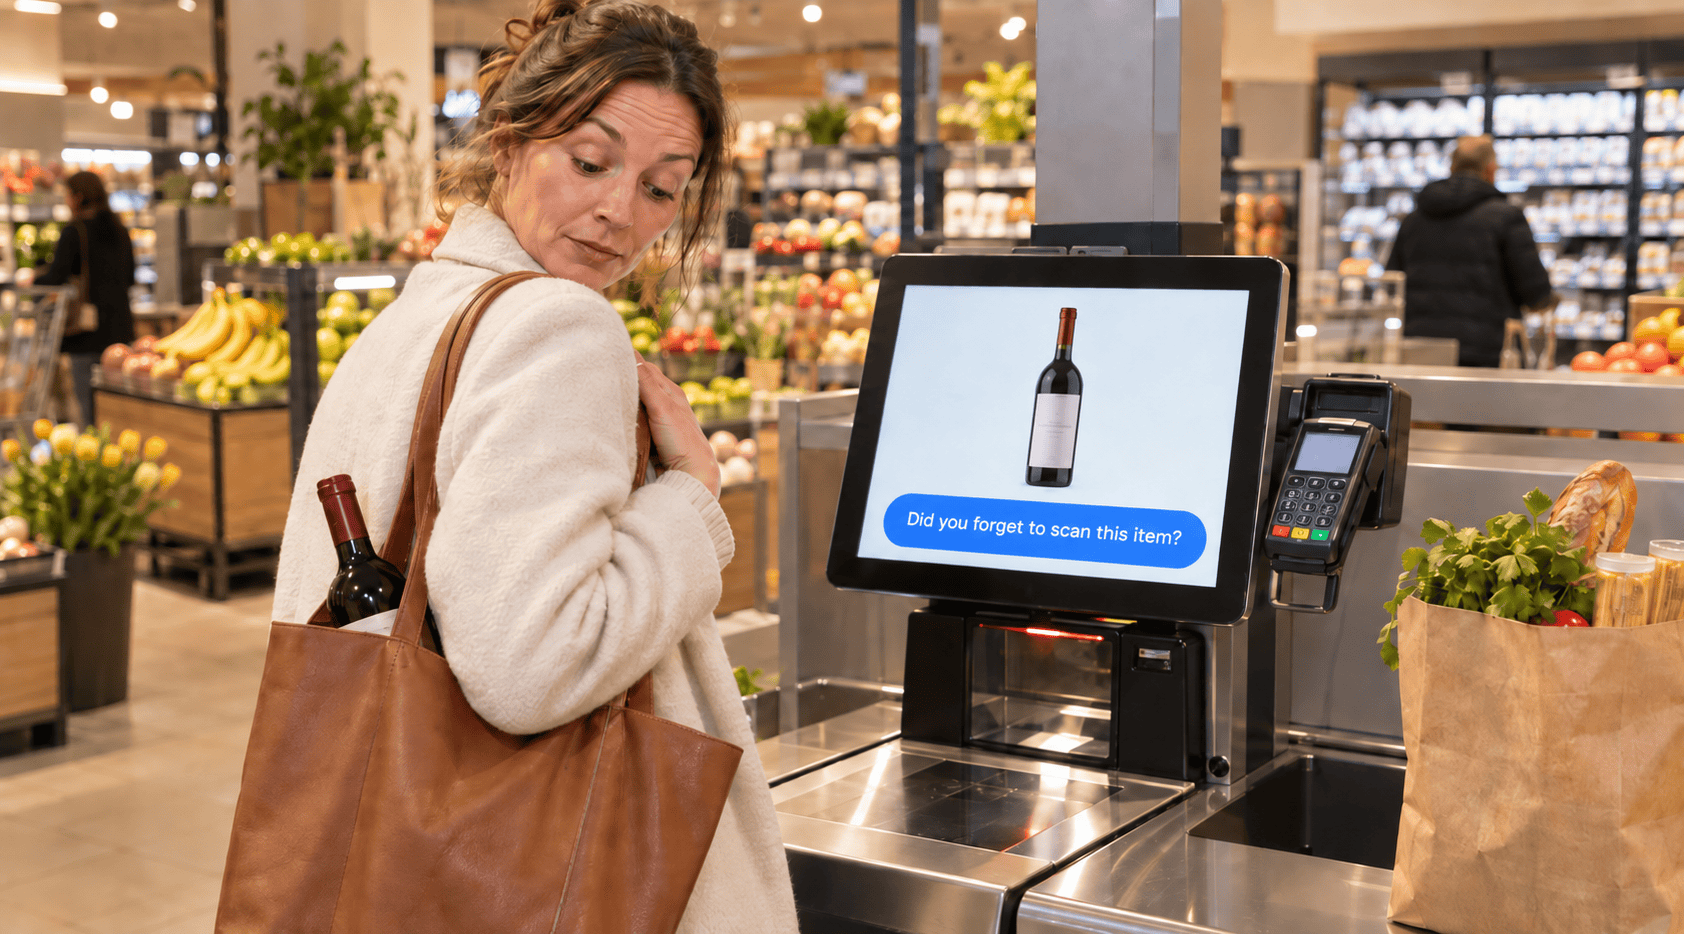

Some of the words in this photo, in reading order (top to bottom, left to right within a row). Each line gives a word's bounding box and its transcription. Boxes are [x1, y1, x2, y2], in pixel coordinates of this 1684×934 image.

[906, 511, 934, 528] Did
[938, 517, 969, 532] you
[973, 515, 1024, 537] forget
[1028, 521, 1046, 536] to
[1050, 525, 1091, 539] scan
[1096, 525, 1128, 542] this
[1133, 527, 1183, 546] item?
